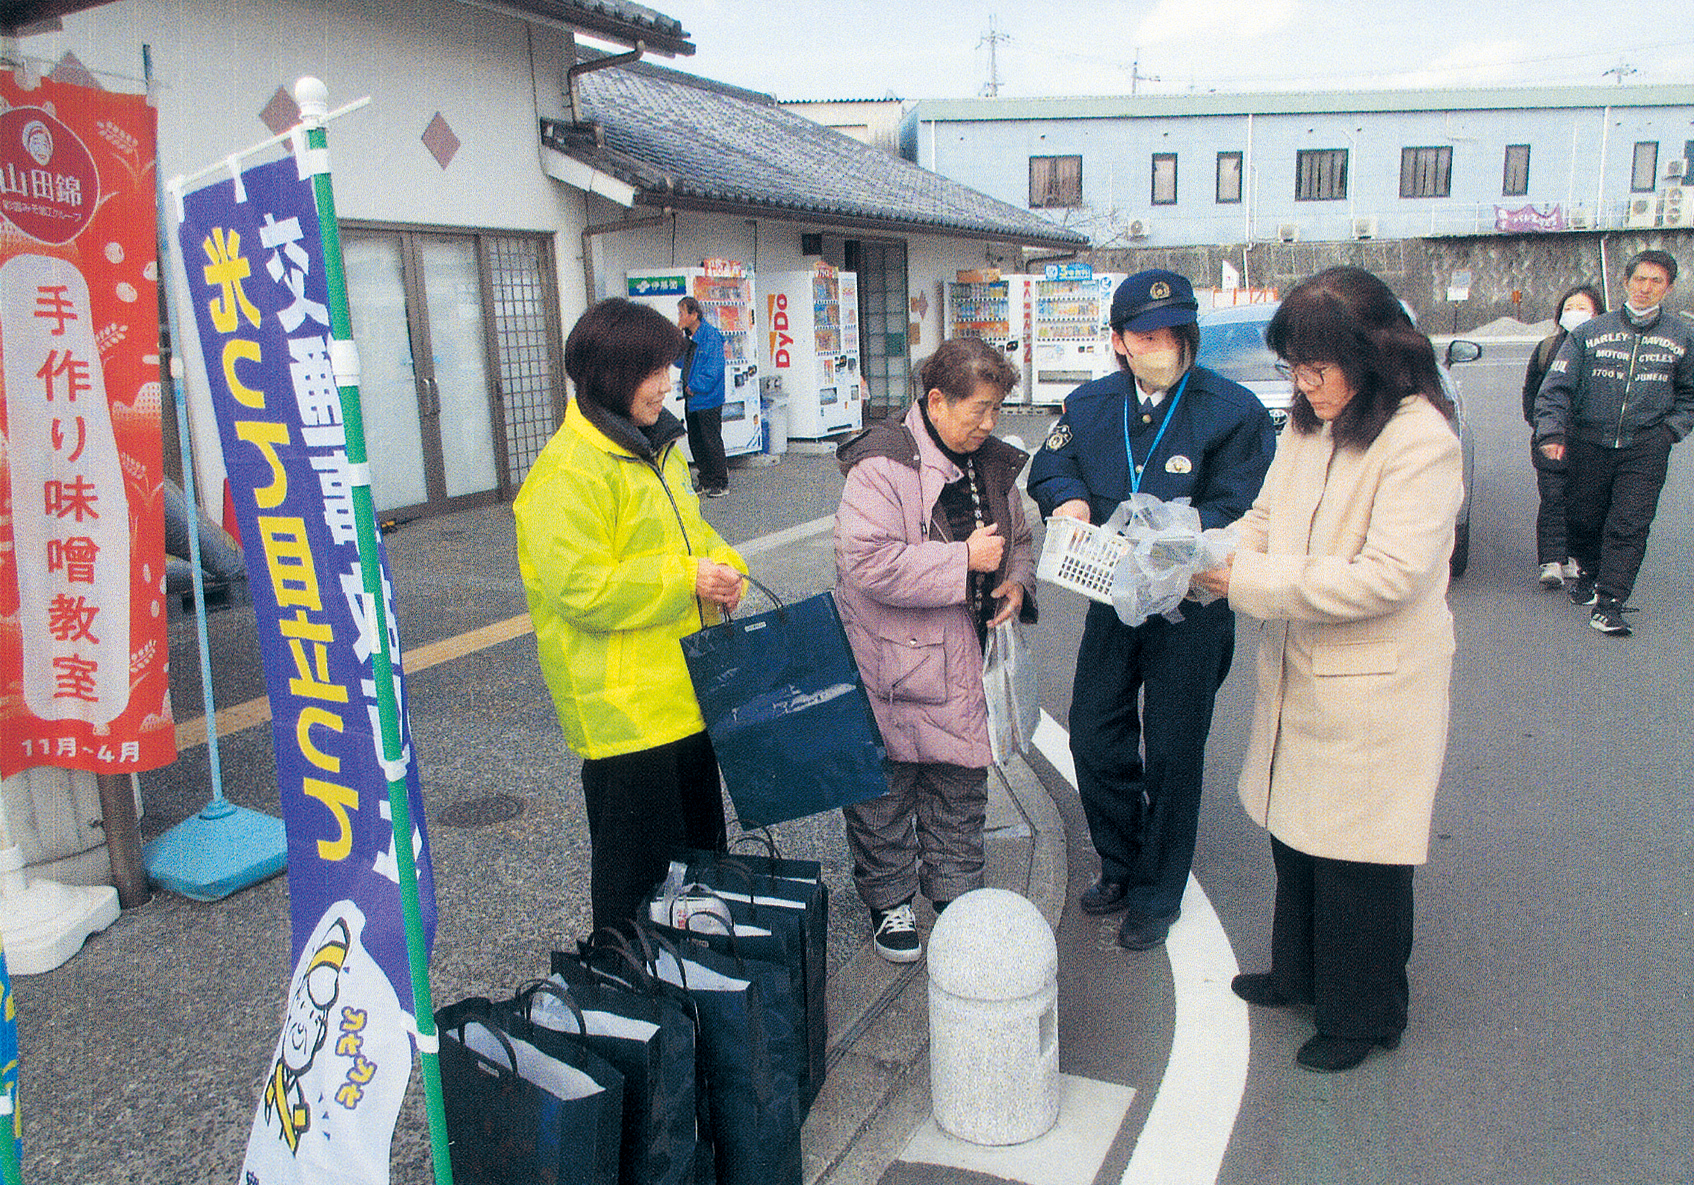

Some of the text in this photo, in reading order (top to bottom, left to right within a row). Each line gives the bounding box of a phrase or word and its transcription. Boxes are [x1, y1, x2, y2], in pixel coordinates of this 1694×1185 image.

[0, 162, 82, 207] 山田錦
[773, 293, 794, 368] DyDo
[1595, 349, 1674, 364] MOTOR CYCLES
[33, 284, 101, 702] 手作り味噌教室
